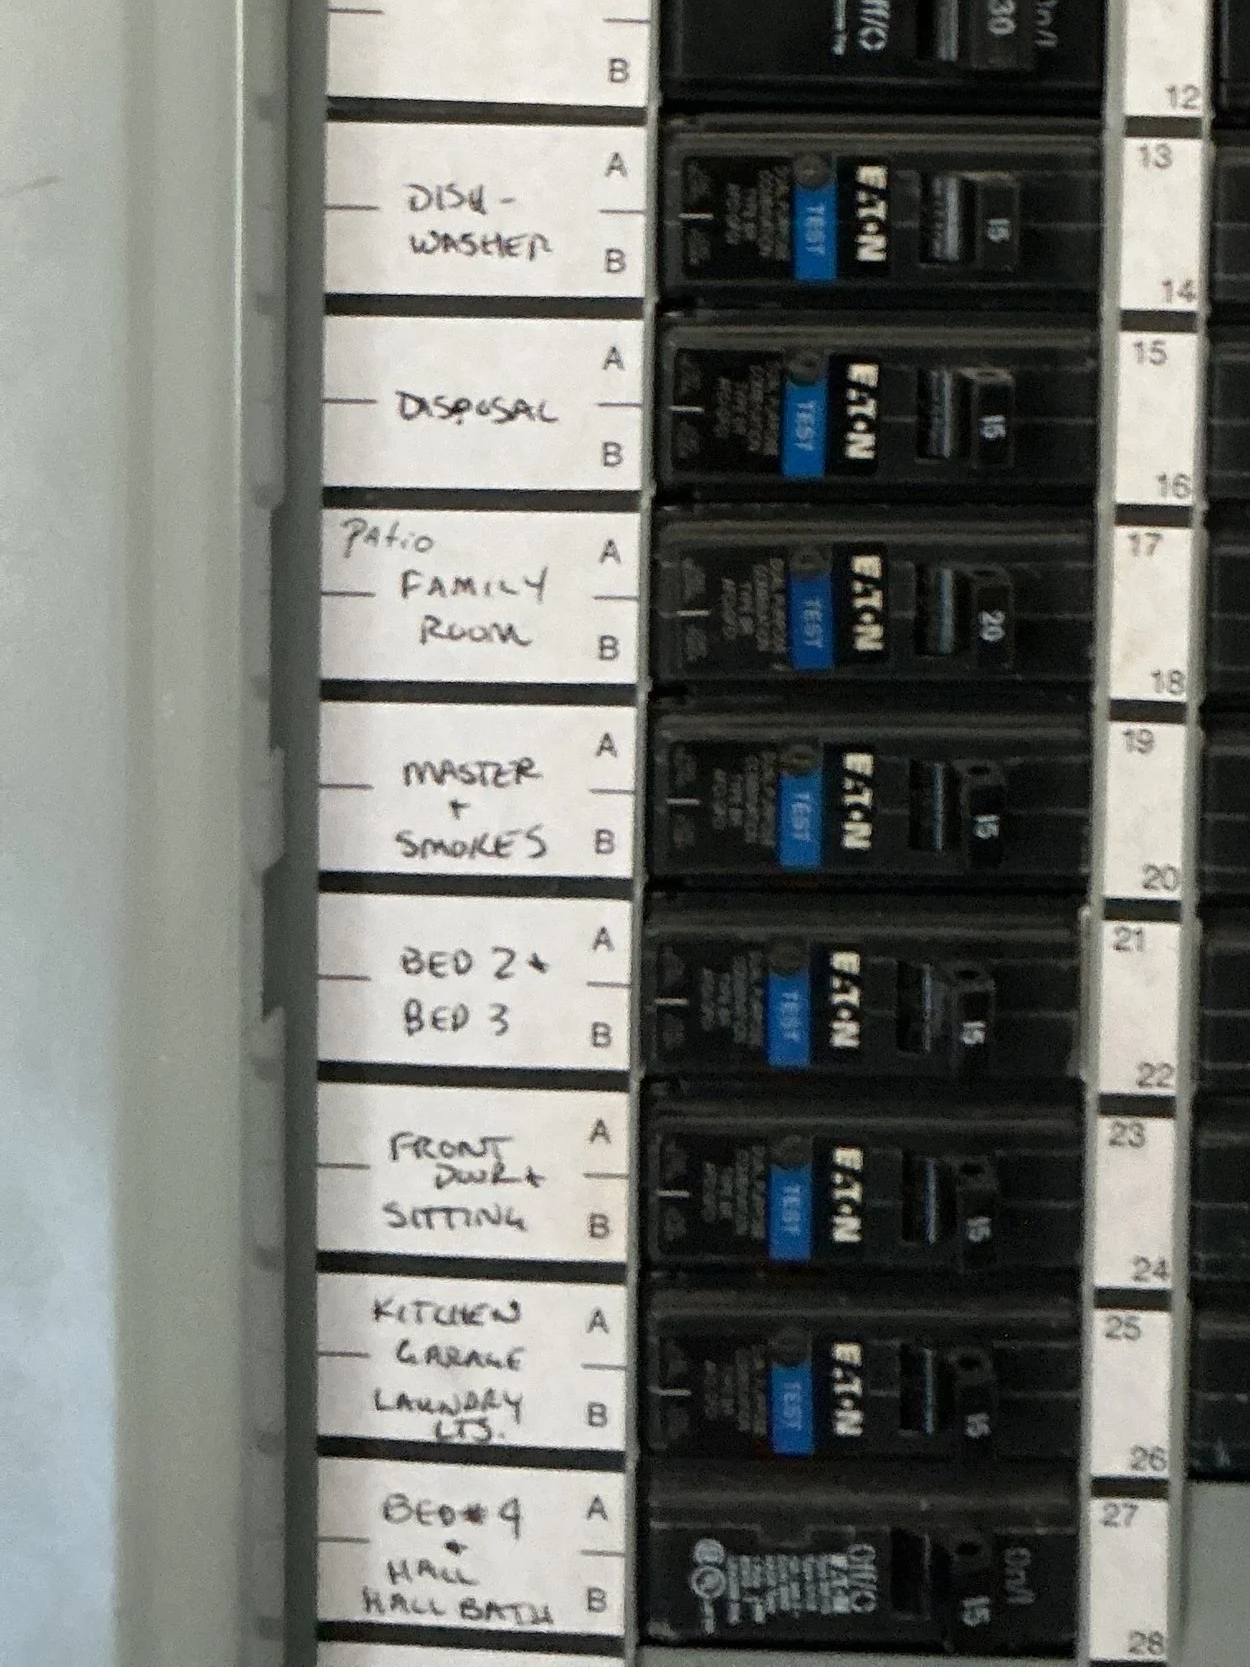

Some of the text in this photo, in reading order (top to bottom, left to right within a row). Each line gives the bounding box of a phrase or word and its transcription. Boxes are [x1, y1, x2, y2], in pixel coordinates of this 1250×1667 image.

[1165, 84, 1202, 111] 12
[604, 152, 628, 177] A
[1138, 143, 1173, 170] 13
[408, 231, 553, 262] WASHER
[604, 247, 627, 275] B
[1161, 278, 1197, 304] 14
[1133, 339, 1168, 366] 15
[1156, 472, 1194, 499] 16
[598, 538, 621, 564] A
[1127, 532, 1161, 558] 17
[401, 565, 548, 604] FAMILY
[420, 614, 532, 647] ROOM
[979, 609, 1006, 642] 20
[596, 634, 620, 661] B
[1150, 669, 1187, 696] 18
[1121, 728, 1155, 755] 19
[403, 756, 543, 789] MASTER
[395, 824, 548, 860] SMOKES
[1141, 863, 1181, 892] 20
[591, 926, 615, 952] A
[1113, 925, 1145, 951] 21
[400, 945, 474, 979] BED
[403, 997, 510, 1037] BED 3
[589, 1021, 613, 1049] B
[1135, 1061, 1175, 1089] 22
[389, 1131, 514, 1162] FRONT
[1108, 1122, 1147, 1149] 23
[382, 1200, 528, 1232] SITTING
[1131, 1255, 1171, 1283] 24
[373, 1295, 522, 1327] KITCHEN
[586, 1307, 610, 1334] A
[1104, 1315, 1142, 1341] 25
[395, 1338, 528, 1372] GARAGE
[374, 1386, 524, 1425] LAUNDRY
[585, 1401, 609, 1428] B
[1129, 1445, 1168, 1472] 26
[382, 1492, 457, 1528] BED
[1101, 1502, 1138, 1528] 27
[387, 1558, 480, 1586] HALL
[362, 1586, 447, 1617] HALL
[1127, 1630, 1166, 1656] 28
